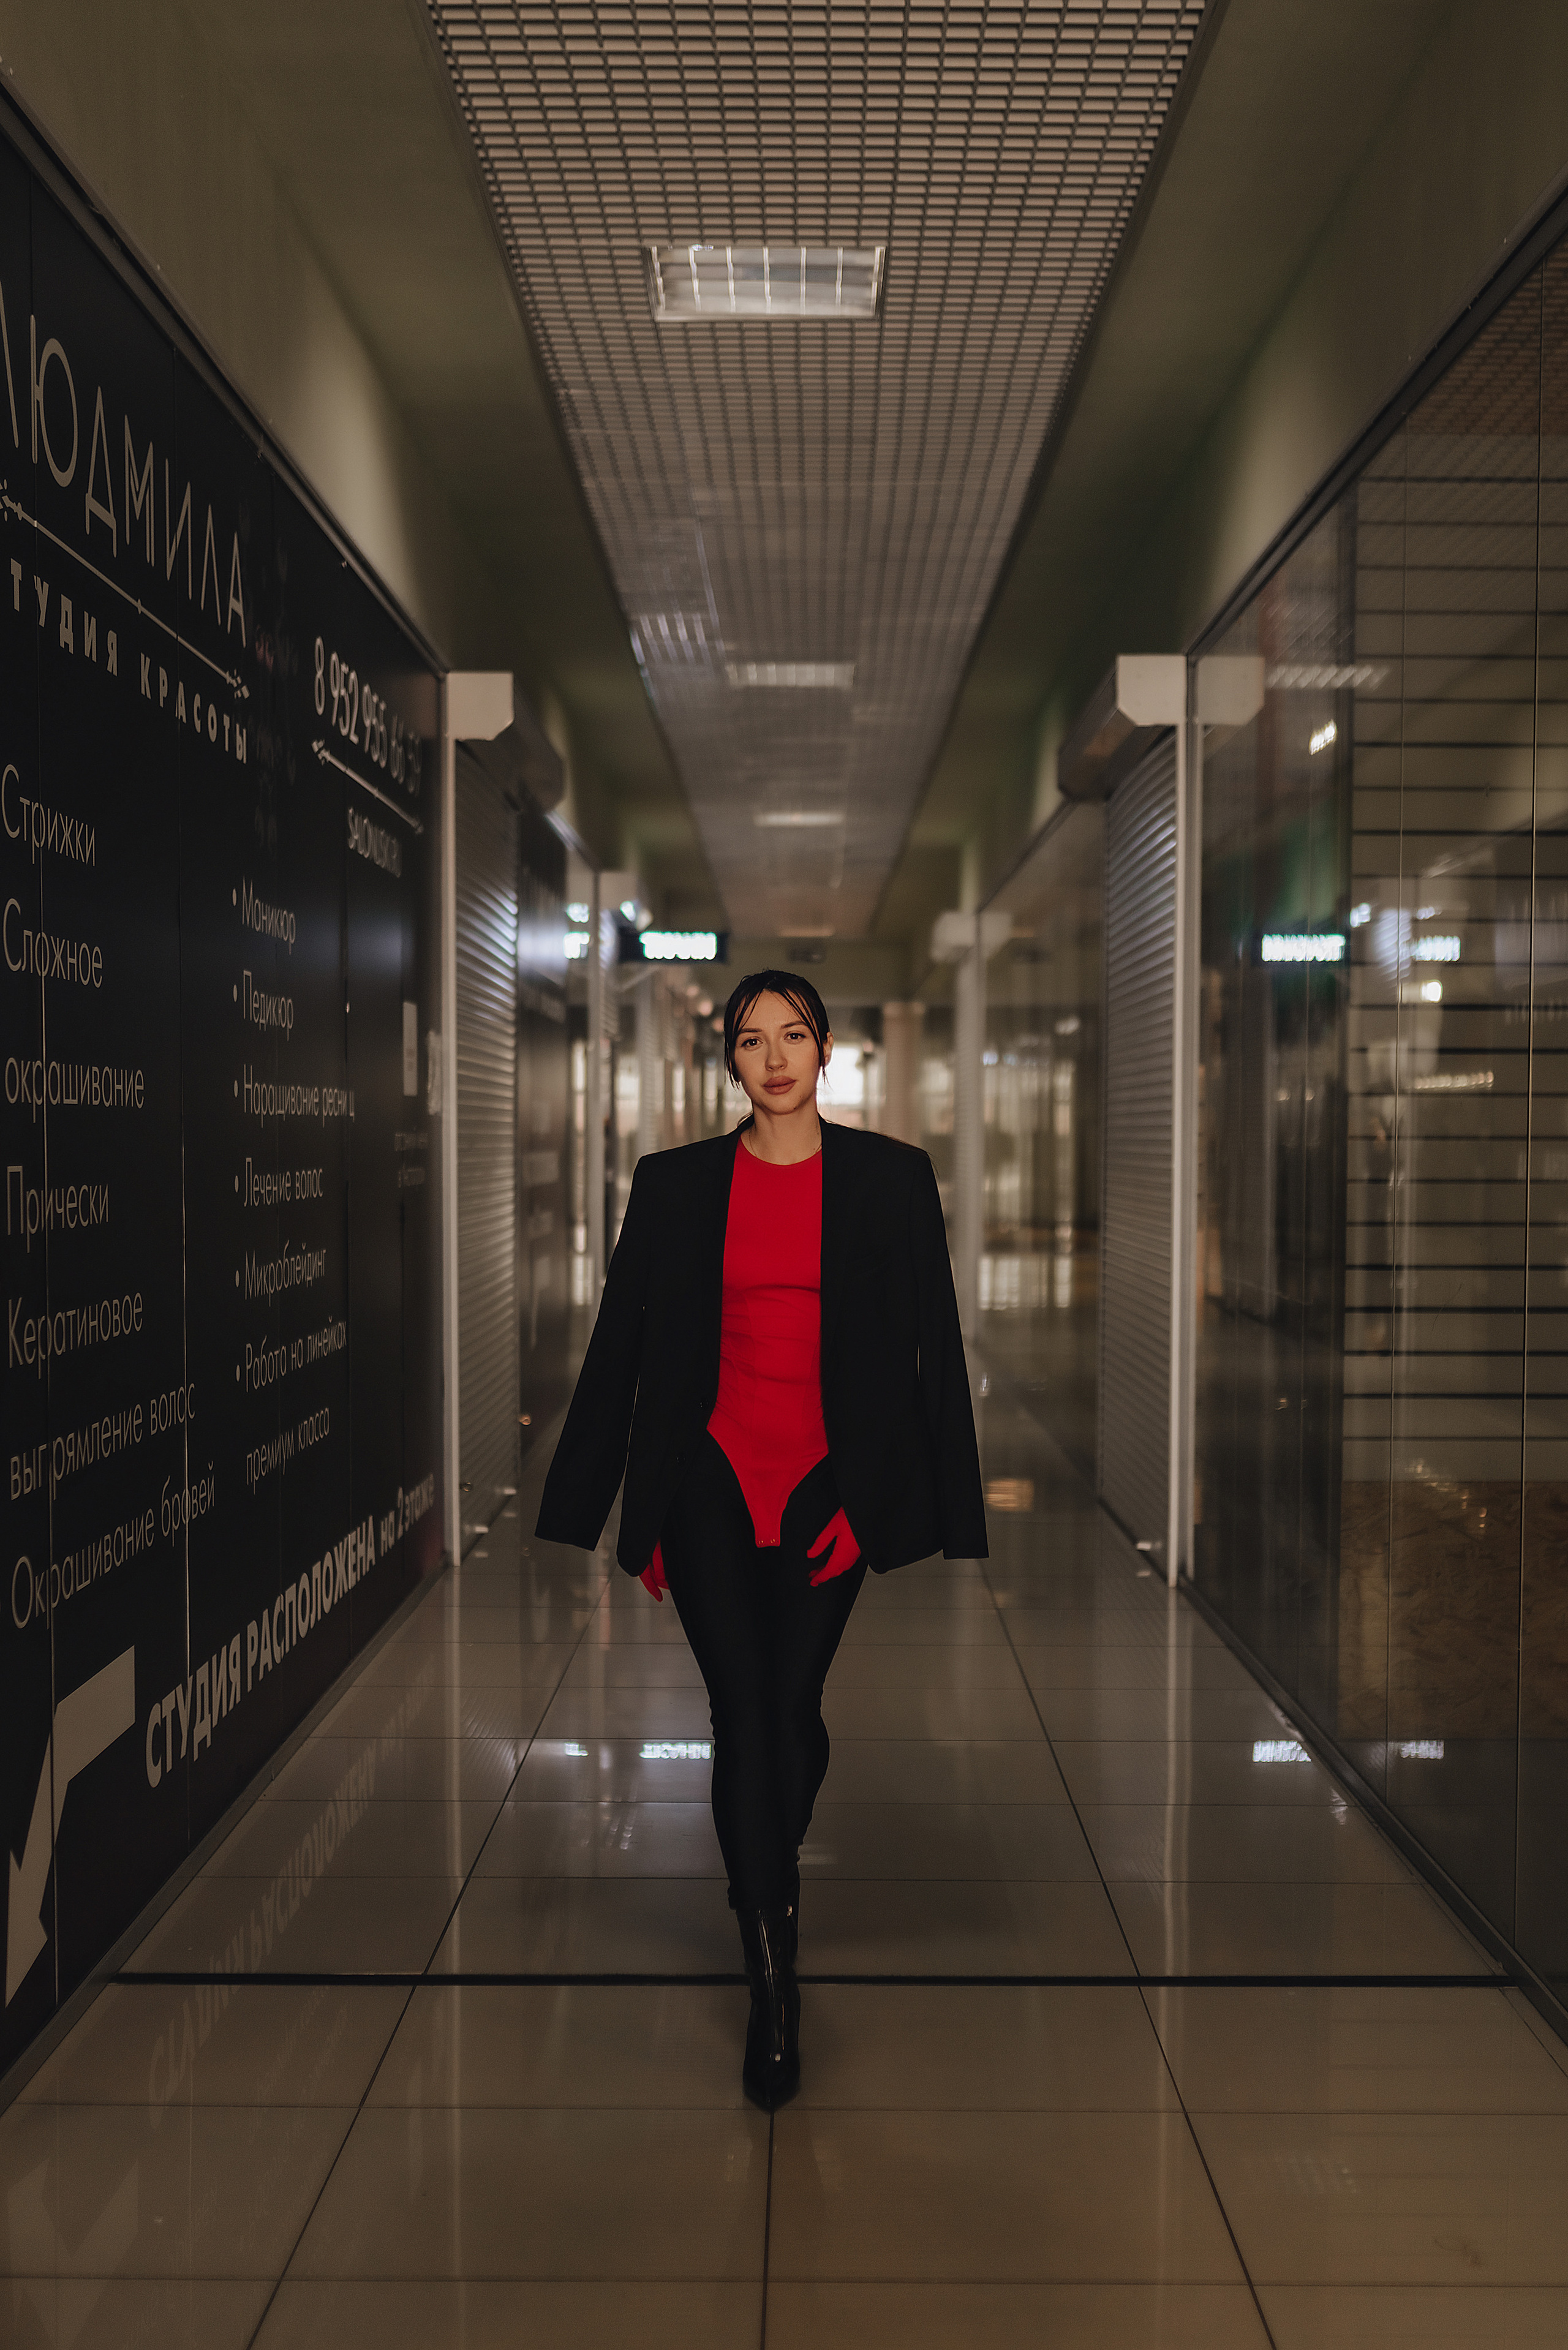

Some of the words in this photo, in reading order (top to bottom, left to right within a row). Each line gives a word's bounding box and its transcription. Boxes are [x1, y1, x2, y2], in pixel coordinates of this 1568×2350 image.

[140, 651, 246, 765] КРАСОТЫ
[314, 635, 325, 716] 8
[330, 651, 360, 746] 952
[361, 682, 387, 770] 955
[1, 764, 96, 867] Стрижки
[3, 898, 103, 989] Сложное
[242, 875, 296, 955] Маникюр
[243, 970, 294, 1041] Педикюр
[5, 1057, 145, 1123] окрашивание
[244, 1063, 319, 1128] Наращивание
[6, 1166, 110, 1253] Прически
[244, 1158, 292, 1207] Лечение
[295, 1167, 323, 1201] волос
[244, 1240, 327, 1308] Микроблейдинг
[8, 1290, 143, 1379] Кератиновое
[246, 1335, 287, 1393] Работа
[291, 1338, 303, 1371] на
[307, 1315, 347, 1364] линейках
[10, 1403, 143, 1501] выпрямление
[150, 1382, 195, 1436] волос
[246, 1428, 295, 1495] премиум
[298, 1407, 330, 1452] класса
[11, 1507, 154, 1630] Окрашивание
[161, 1460, 215, 1547] бровей
[145, 1632, 241, 1788] СТУДИЯ
[247, 1515, 375, 1692] РАСПОЛОЖЕНА
[380, 1510, 395, 1557] на
[398, 1486, 404, 1540] 2
